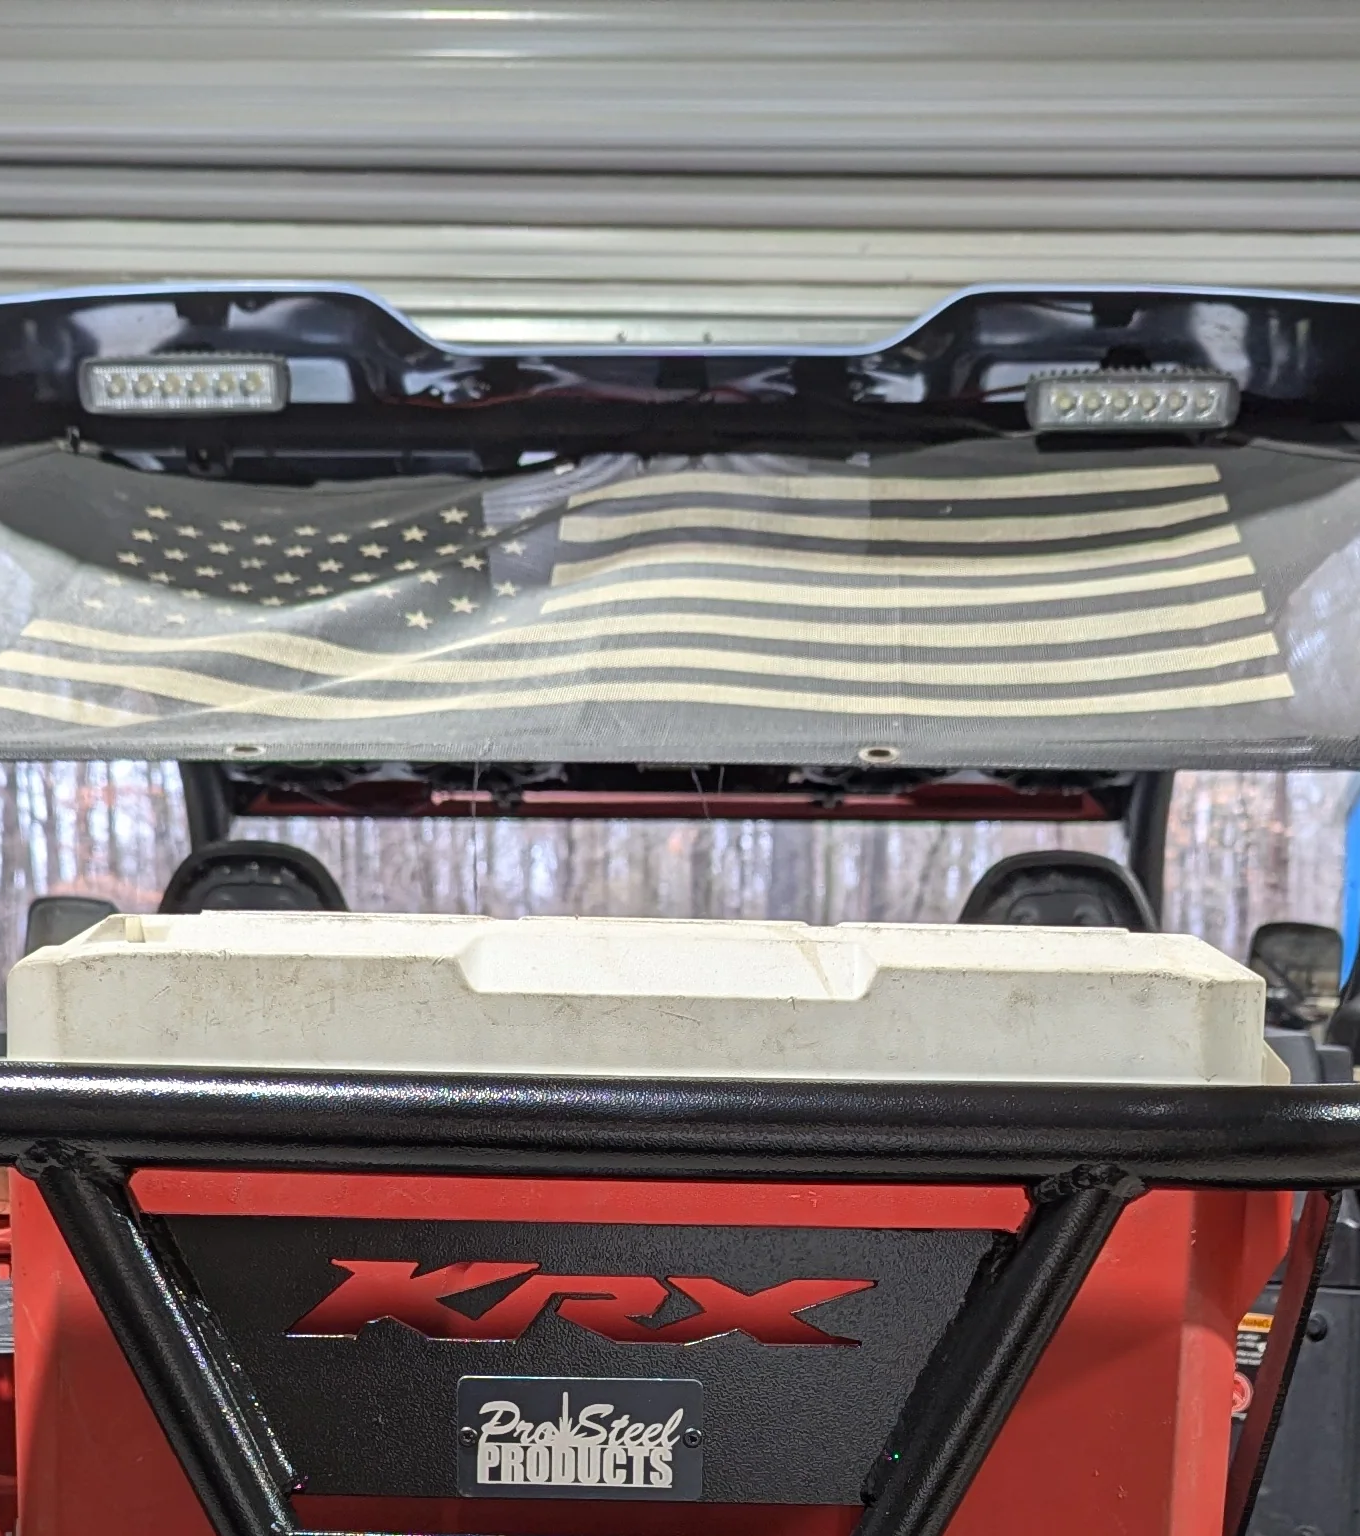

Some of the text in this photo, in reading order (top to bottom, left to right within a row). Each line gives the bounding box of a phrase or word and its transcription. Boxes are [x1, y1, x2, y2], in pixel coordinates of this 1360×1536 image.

[285, 1258, 879, 1347] KRX
[478, 1400, 684, 1449] Pro Steel
[477, 1442, 673, 1488] PRODUCTS
